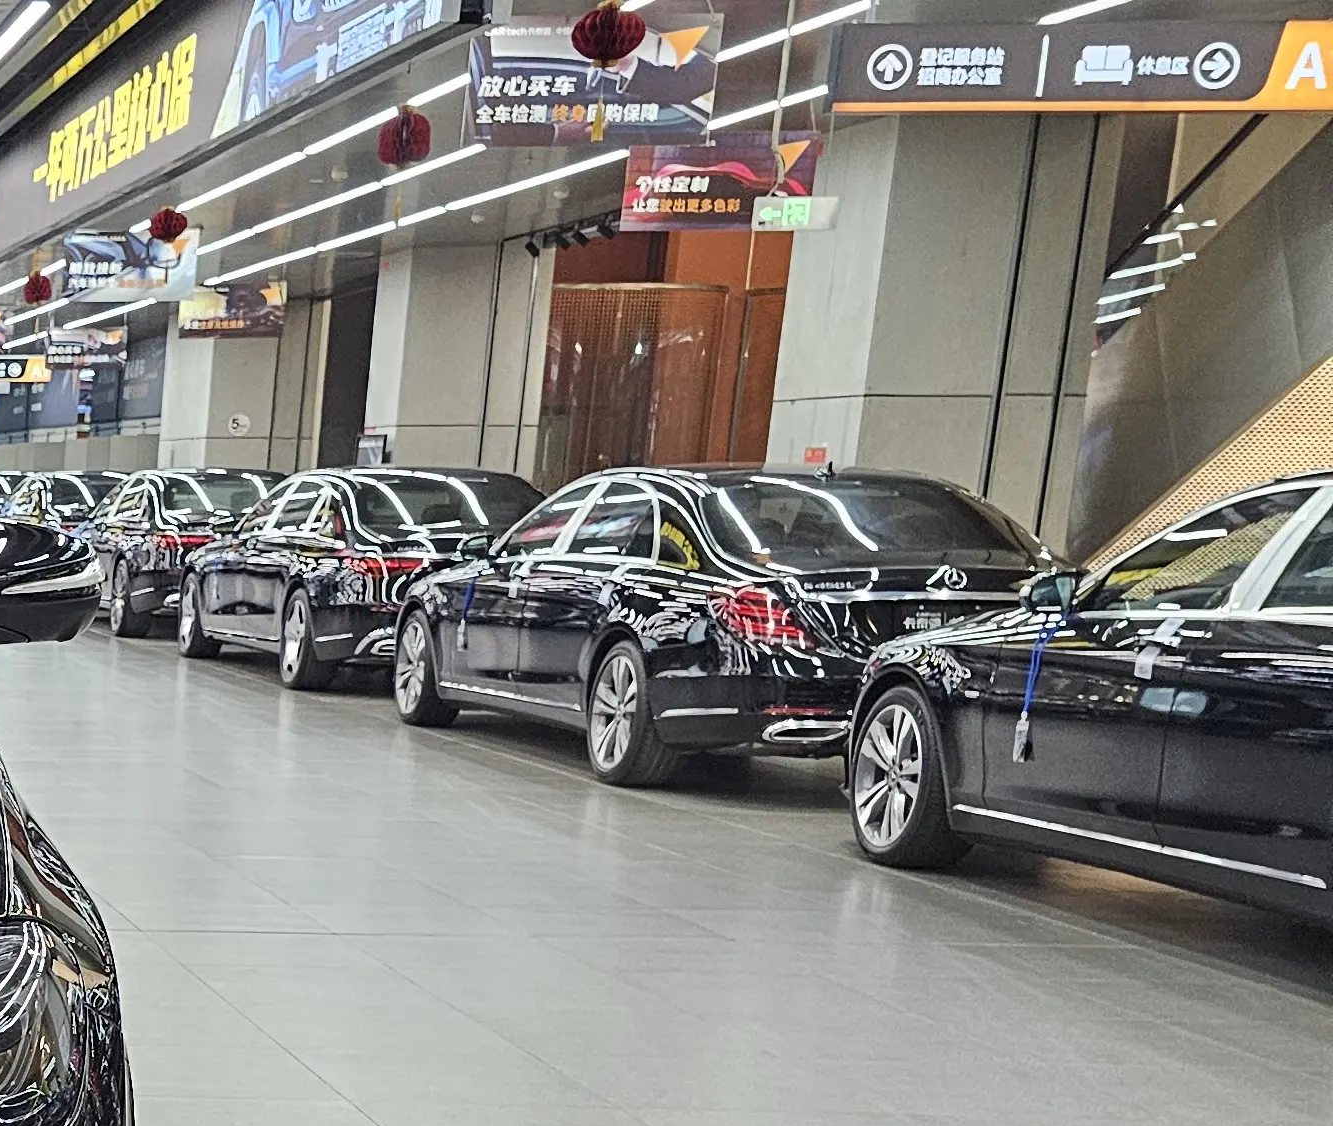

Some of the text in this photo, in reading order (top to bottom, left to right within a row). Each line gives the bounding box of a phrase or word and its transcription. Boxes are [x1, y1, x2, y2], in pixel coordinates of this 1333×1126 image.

[1137, 55, 1190, 77] 休息区
[1285, 41, 1327, 90] A
[479, 75, 577, 97] 放心买车
[476, 104, 548, 124] 全车检测
[636, 175, 710, 193] 个性定制
[232, 418, 240, 430] 5
